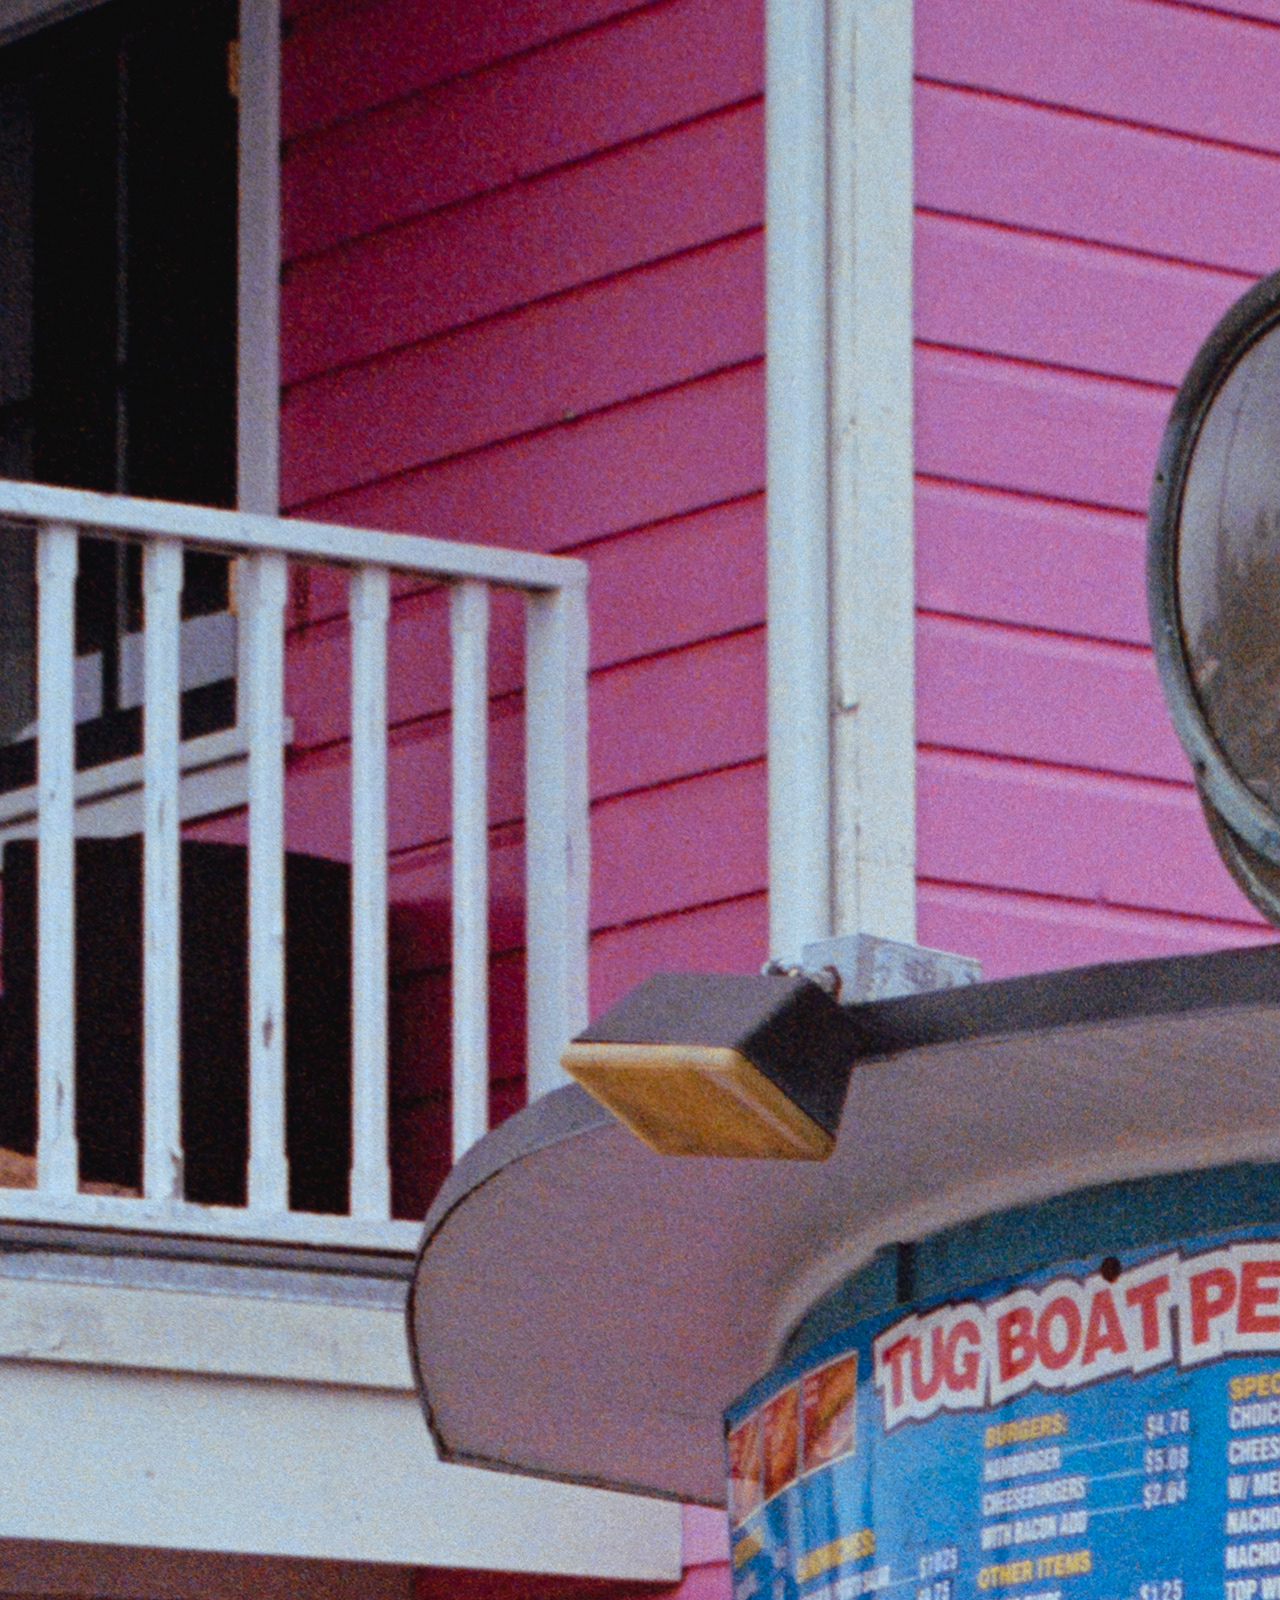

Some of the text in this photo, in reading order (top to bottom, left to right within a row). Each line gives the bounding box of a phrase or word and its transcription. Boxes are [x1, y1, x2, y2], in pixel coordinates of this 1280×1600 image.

[882, 1320, 981, 1408] TUG
[997, 1275, 1171, 1384] BOAT
[976, 1549, 1092, 1590] OTHER ITEMS
